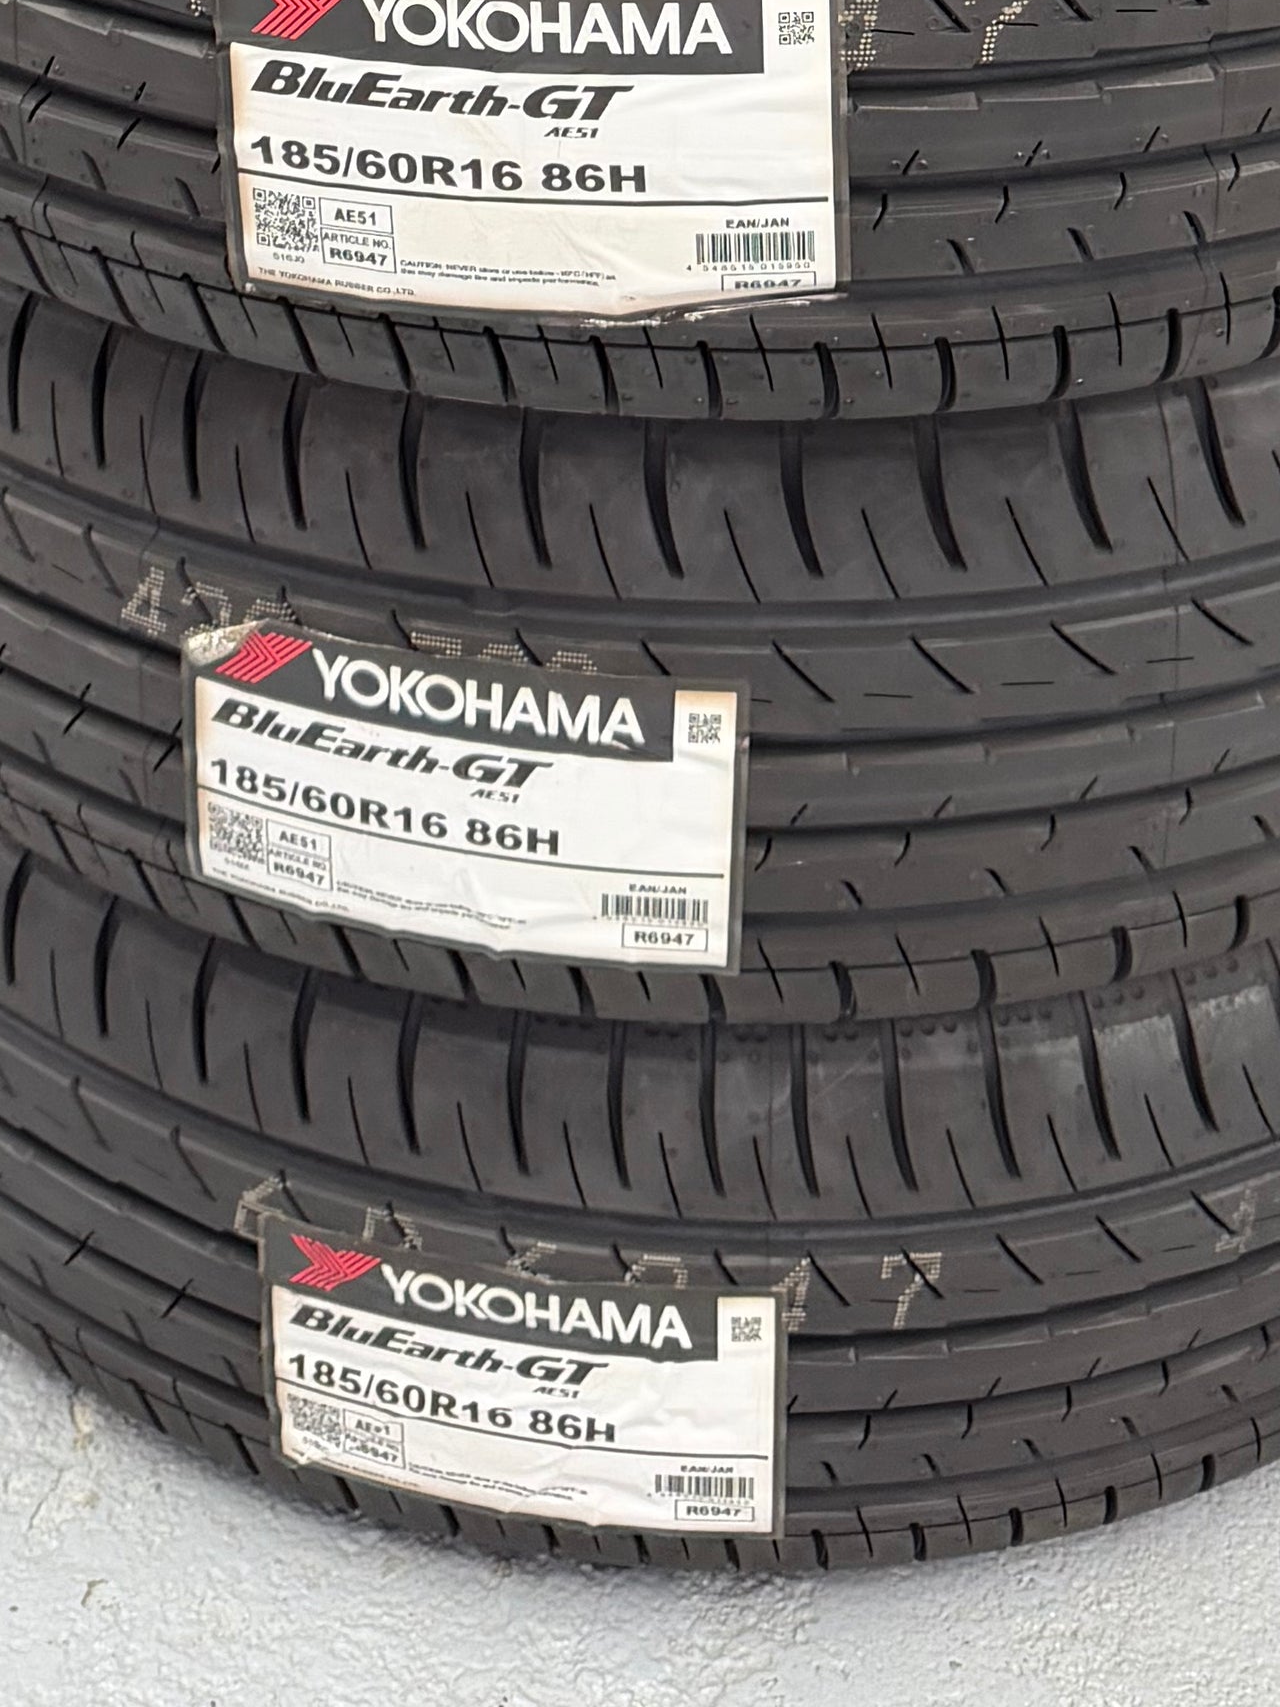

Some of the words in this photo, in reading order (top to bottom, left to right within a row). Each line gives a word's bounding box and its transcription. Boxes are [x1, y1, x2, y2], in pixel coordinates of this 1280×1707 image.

[250, 59, 636, 124] BluEarth-GT
[543, 125, 600, 142] AE51
[249, 134, 525, 191] 185/60R16
[541, 161, 648, 195] 86H
[333, 206, 378, 227] AE51
[725, 217, 790, 229] EAN/JAN
[321, 231, 370, 248] ARTICLE
[329, 247, 388, 267] R6947
[312, 649, 646, 747] YOKOHAMA
[210, 697, 555, 789] BluEarth-GT
[469, 786, 521, 805] AE51
[209, 757, 449, 840] 185/60R16
[465, 822, 561, 858] 86H
[278, 829, 318, 850] AE51
[272, 861, 325, 886] R6947
[633, 930, 695, 946] R6947
[381, 1263, 694, 1351] YOKOHAMA
[288, 1302, 610, 1388] BluEarth-GT
[287, 1352, 514, 1429] 185/60R16
[528, 1411, 617, 1443] 86H
[532, 1385, 582, 1400] AE51
[686, 1505, 742, 1517] R6947
